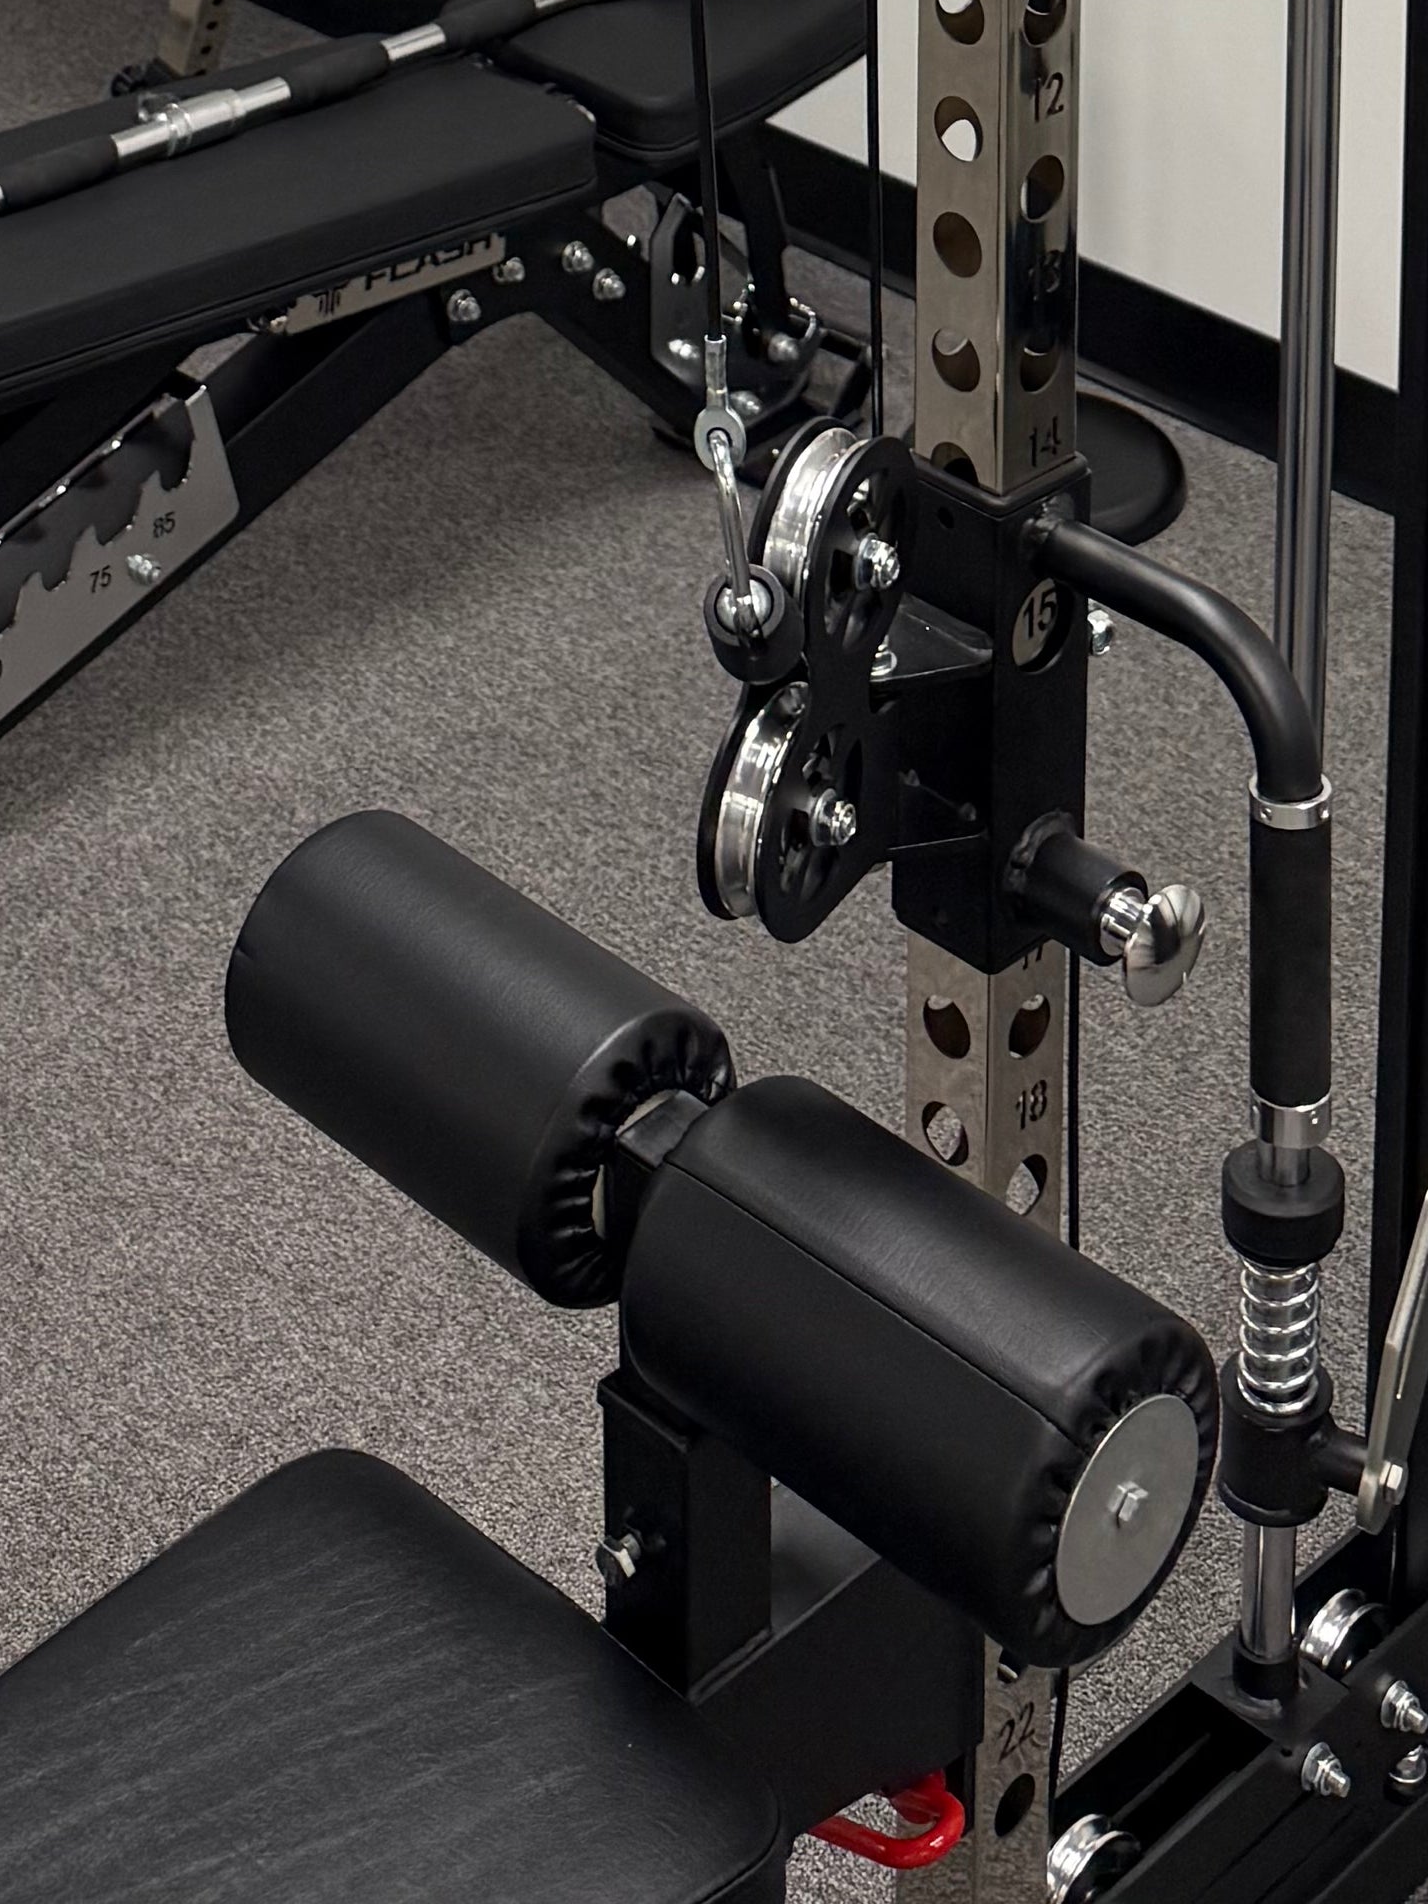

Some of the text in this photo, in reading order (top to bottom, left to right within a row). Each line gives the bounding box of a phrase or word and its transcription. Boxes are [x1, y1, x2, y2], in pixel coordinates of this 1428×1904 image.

[1029, 72, 1065, 124] 12
[1029, 416, 1062, 468] 14
[152, 510, 176, 539] 85
[88, 565, 113, 594] 75
[1023, 588, 1058, 639] 15
[1015, 1079, 1048, 1130] 18
[999, 1701, 1035, 1763] 22
